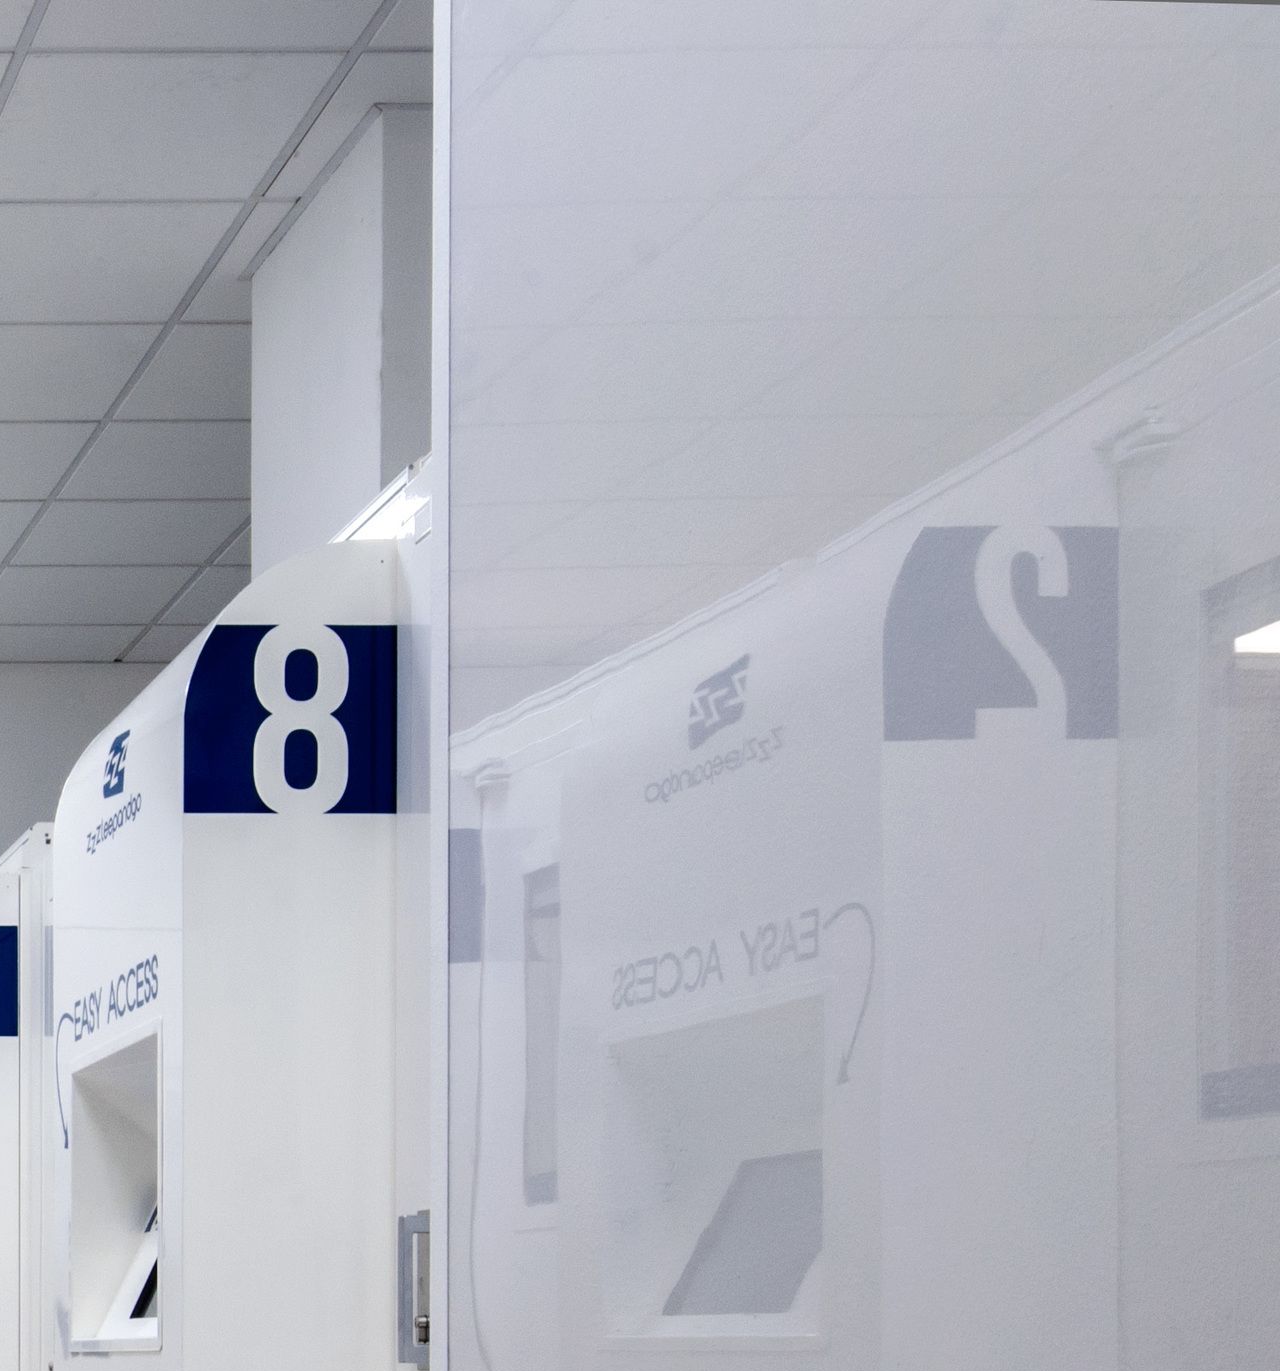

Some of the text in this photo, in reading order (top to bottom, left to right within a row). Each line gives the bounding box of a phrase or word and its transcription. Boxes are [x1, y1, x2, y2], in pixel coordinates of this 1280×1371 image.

[253, 624, 349, 814] 8
[73, 953, 159, 1042] EASY ACCESS
